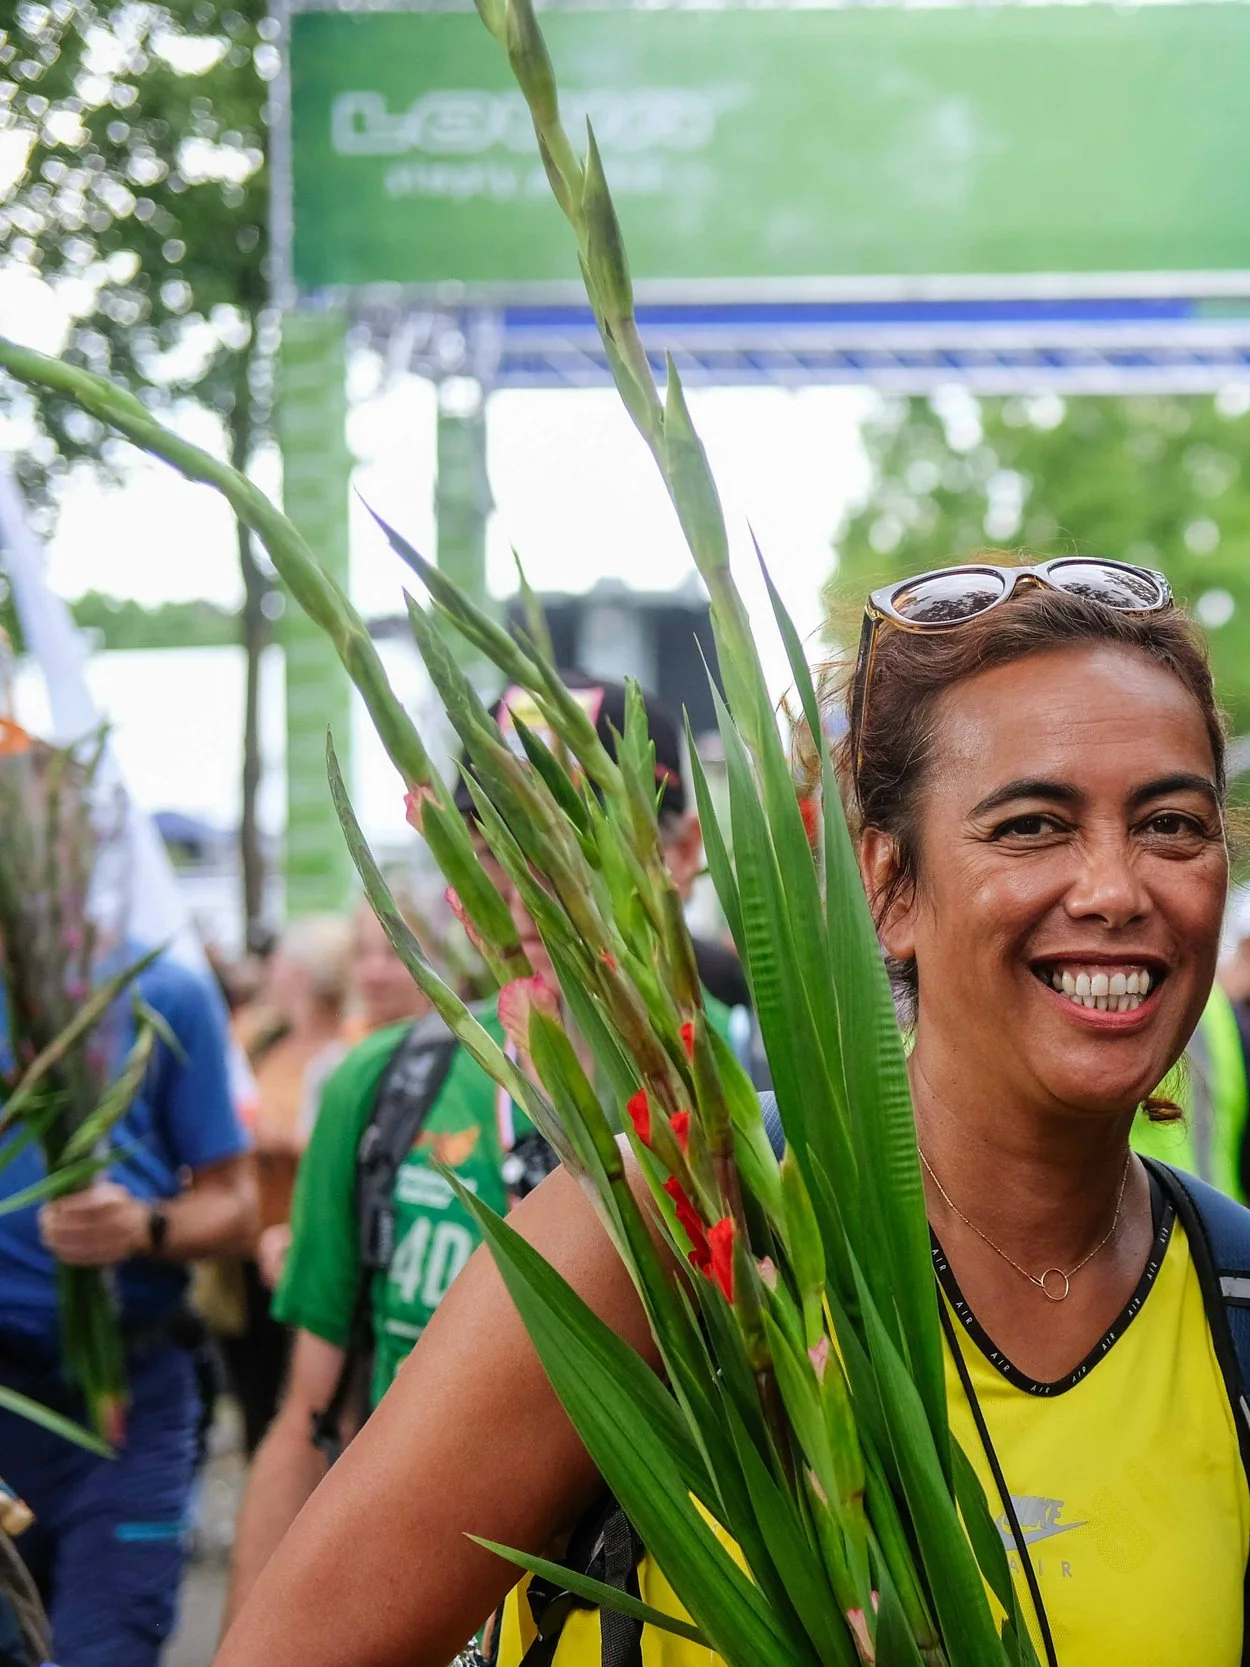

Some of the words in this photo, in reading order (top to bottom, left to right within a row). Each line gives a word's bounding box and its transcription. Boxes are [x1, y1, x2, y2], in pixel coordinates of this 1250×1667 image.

[931, 1248, 947, 1272] AIR
[955, 1301, 973, 1325] AIR
[991, 1352, 1011, 1372] AIR
[1030, 1384, 1051, 1394] AIR
[1101, 1332, 1116, 1351] AIR
[1127, 1298, 1142, 1317] AIR
[1146, 1261, 1158, 1280] AIR
[1009, 1556, 1072, 1578] AIR
